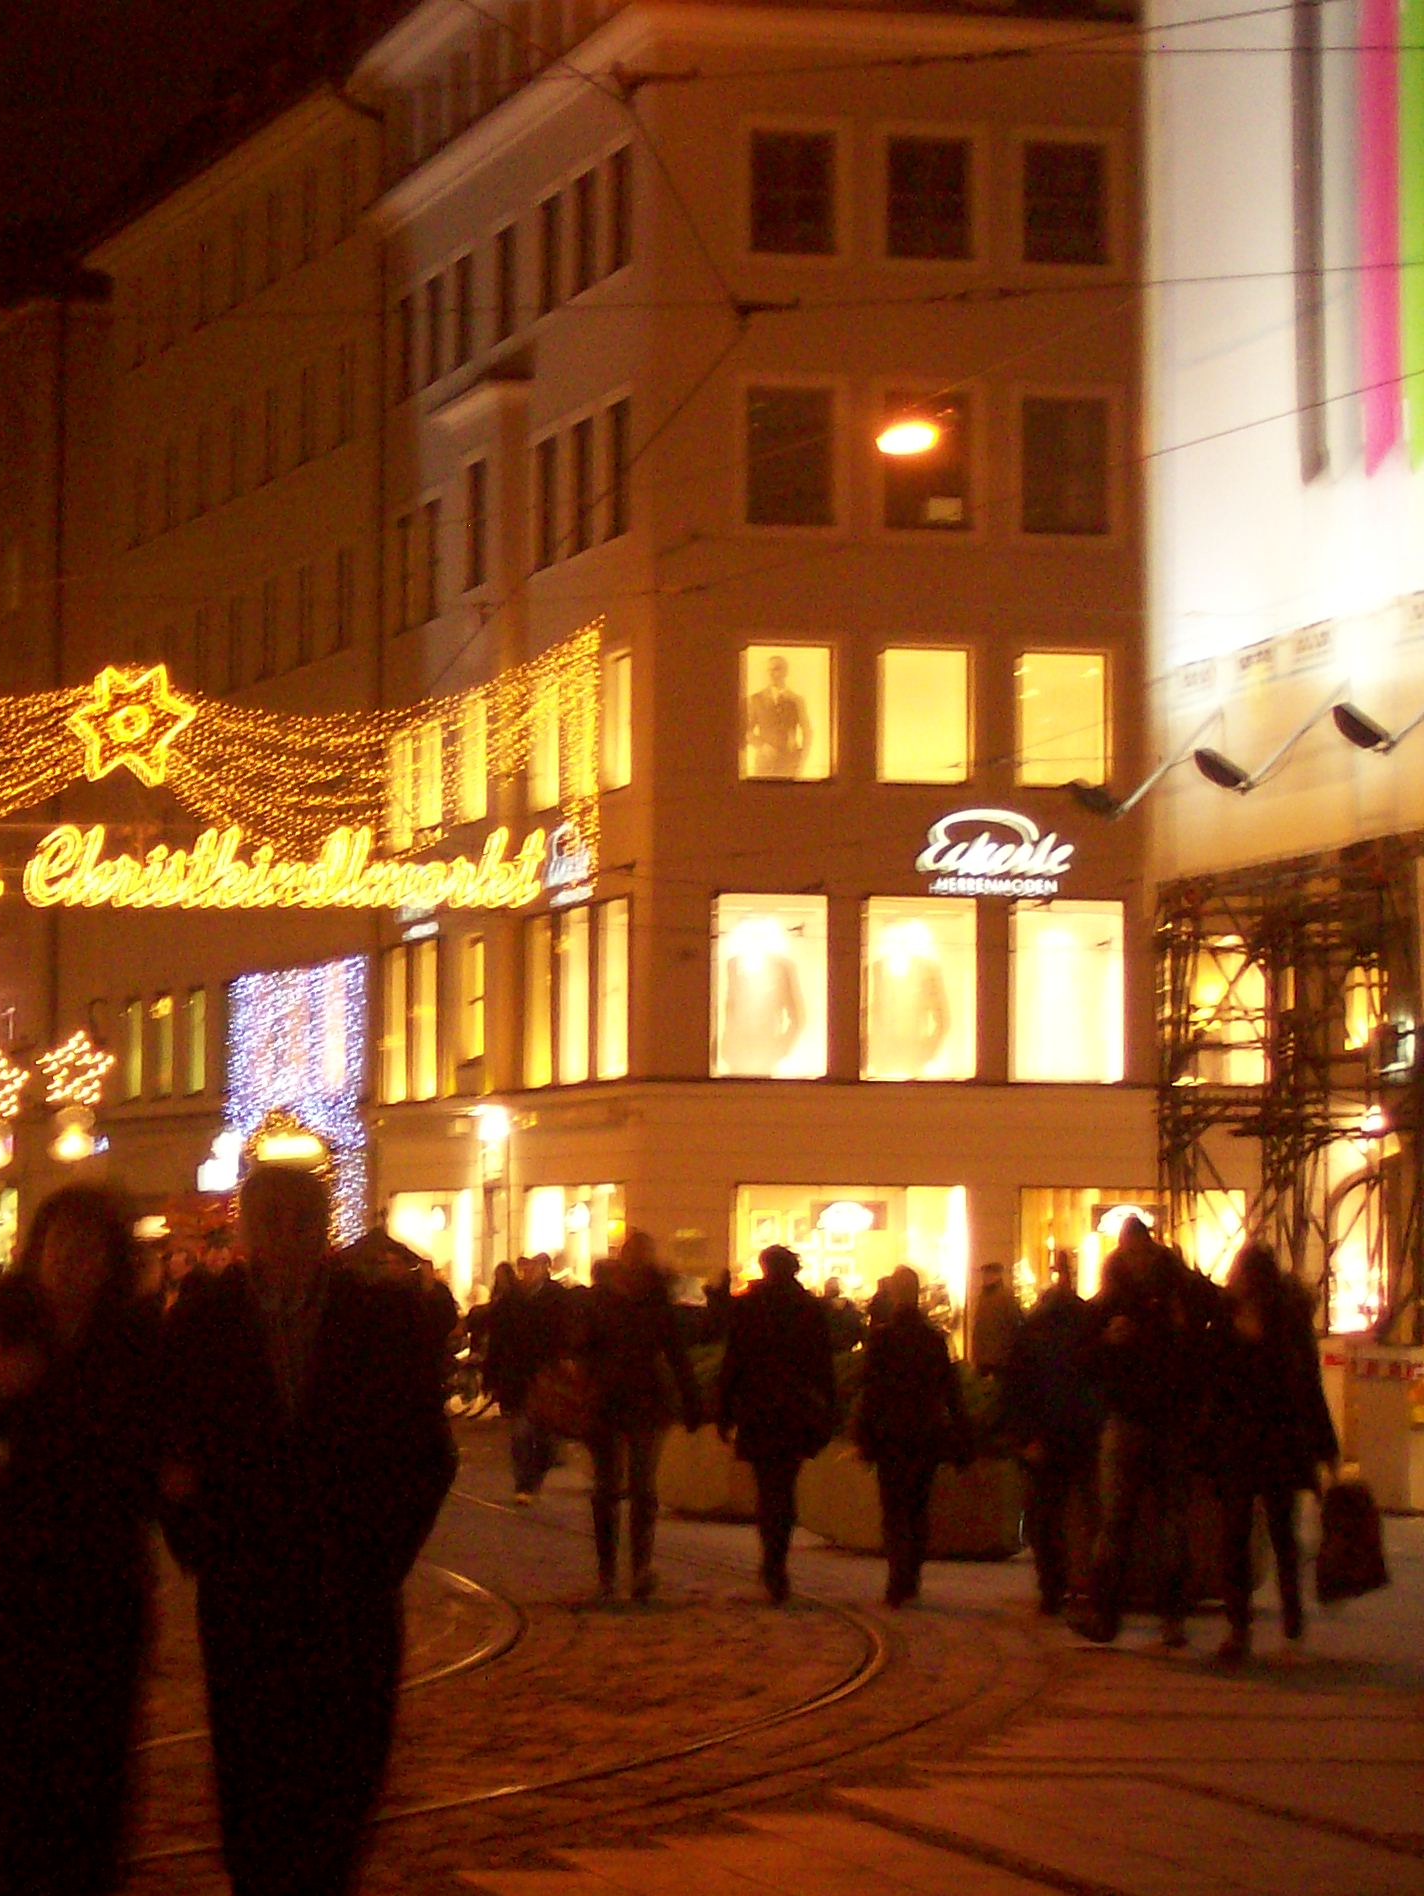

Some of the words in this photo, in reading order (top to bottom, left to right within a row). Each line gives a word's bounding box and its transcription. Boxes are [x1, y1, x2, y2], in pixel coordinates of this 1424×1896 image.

[22, 823, 547, 910] Christkindlmarkt
[915, 808, 1075, 877] Eckerle
[929, 876, 1059, 896] HERRENMODEN
